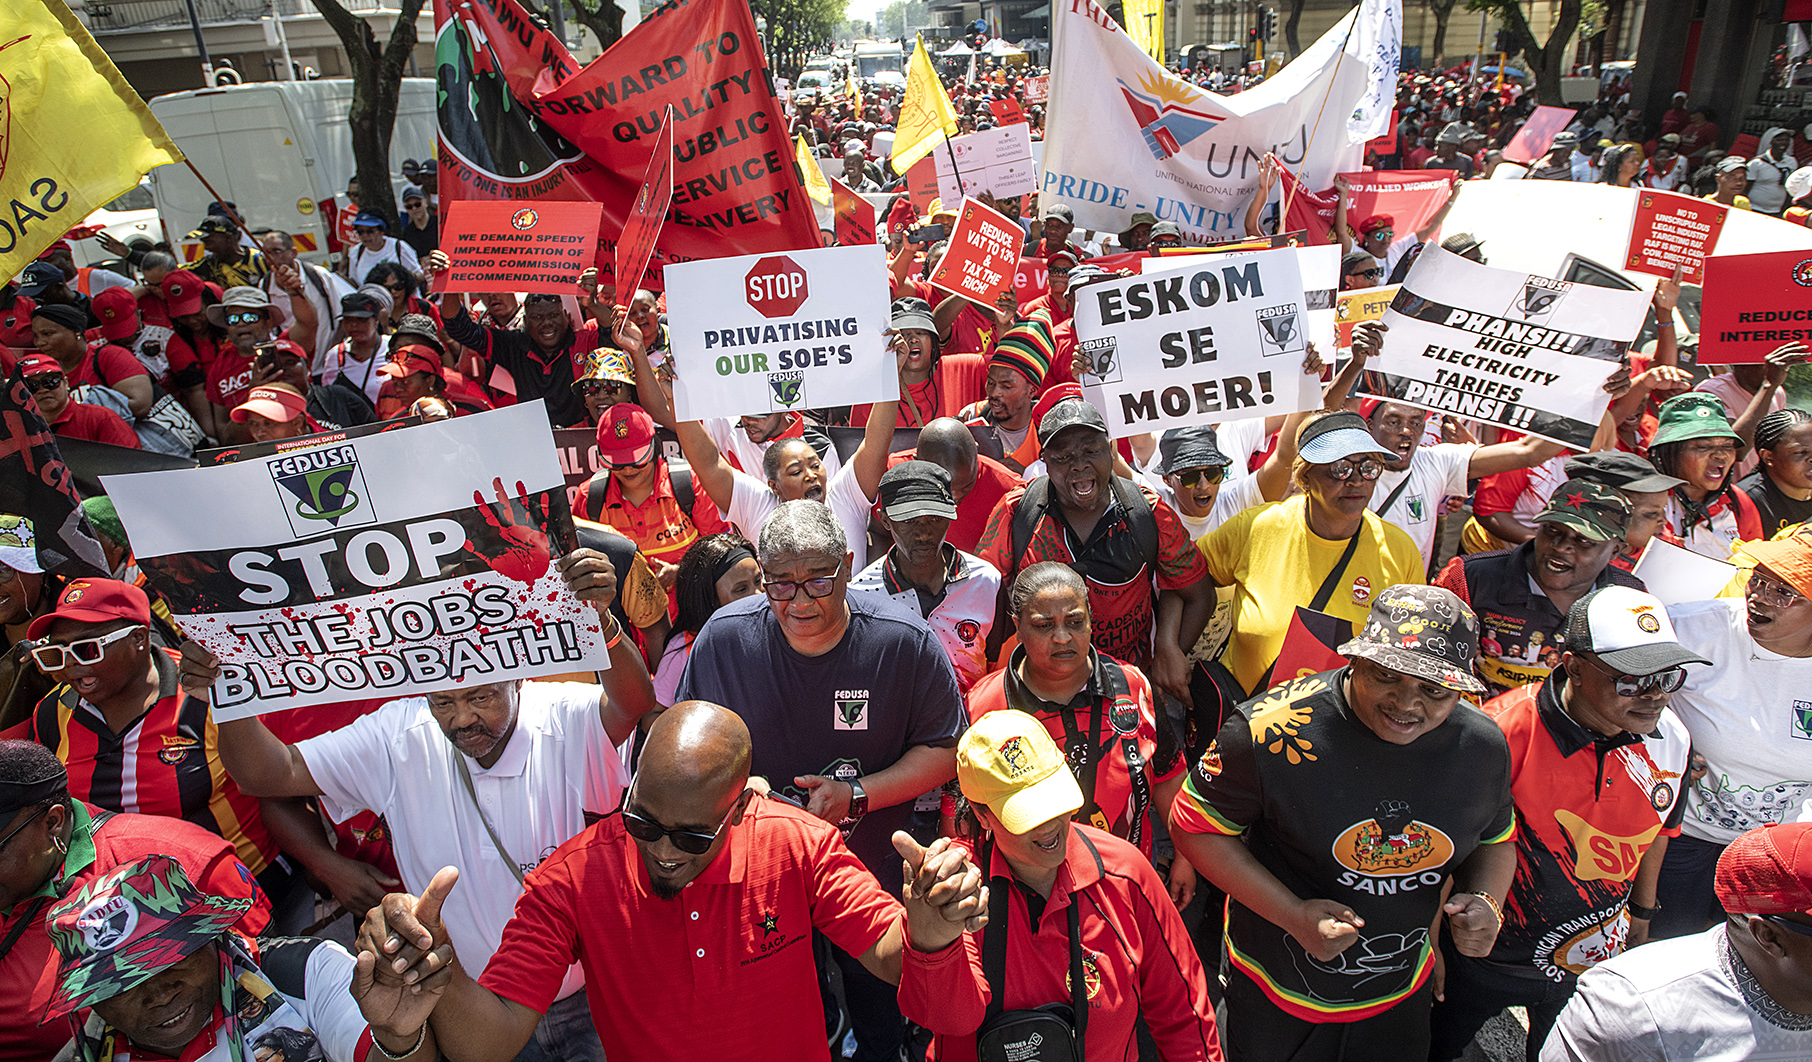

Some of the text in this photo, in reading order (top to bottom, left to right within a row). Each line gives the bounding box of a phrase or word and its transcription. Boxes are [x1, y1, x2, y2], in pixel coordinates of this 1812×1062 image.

[530, 31, 740, 118] FORWARD TO
[612, 69, 752, 143] QUALITY
[673, 111, 769, 163] UBLIC
[473, 176, 498, 195] ONE
[515, 187, 529, 199] AN
[672, 150, 782, 205] ERVICE
[1155, 169, 1184, 185] UNITED
[1187, 181, 1233, 196] NATIONAL
[1365, 183, 1401, 192] ALLIED
[1043, 170, 1129, 210] PRIDE
[1156, 196, 1240, 232] UNITY
[1655, 213, 1711, 232] UNSCRUPULOUS
[1677, 209, 1698, 219] NO TO
[458, 234, 585, 243] WE DEMAND SPEEDY
[979, 221, 1014, 248] REDUCE
[1652, 222, 1709, 241] LEGAL INDUSTRY
[1652, 231, 1690, 246] TARGETING
[453, 247, 584, 257] IMPLEMENTATION OF
[966, 229, 1015, 265] VAT TO 13%
[1644, 239, 1661, 248] RAF
[1661, 242, 1668, 250] IS
[1668, 244, 1682, 253] NOT
[1687, 248, 1705, 258] CASH
[1663, 252, 1685, 263] DIRECT
[1685, 256, 1691, 265] IT
[1692, 258, 1702, 267] TO
[452, 260, 581, 270] ZONDO COMMISSION
[962, 260, 983, 278] TAX
[981, 268, 1002, 287] THE
[982, 255, 991, 267] &
[750, 272, 803, 301] STOP
[960, 275, 988, 295] RICH!
[1097, 262, 1263, 326] ESKOM
[1526, 275, 1573, 293] FEDUSA
[1256, 303, 1297, 318] FEDUSA
[704, 317, 858, 349] PRIVATISING
[1083, 337, 1115, 350] EDUSA
[1443, 309, 1582, 353] PHANSI!!
[1720, 329, 1812, 342] INTEREST
[1160, 326, 1217, 368] SE
[1475, 337, 1533, 359] HIGH
[715, 344, 853, 376] OUR SOE'S
[1422, 344, 1560, 386] ELECTRICITY
[768, 371, 803, 382] FEDUSA
[1435, 369, 1524, 402] TARIFFS
[1119, 370, 1275, 425] MOER!
[1403, 381, 1507, 421] PHANSI
[277, 439, 321, 450] INTERNATIONAL
[270, 444, 356, 477] FEDUSA
[228, 517, 466, 604] STOP
[1094, 588, 1108, 596] ONE
[232, 586, 516, 658] THE JOBS
[211, 620, 581, 707] BLOODBATH!
[834, 689, 869, 700] FEDUSA
[1336, 871, 1442, 896] SANCO
[760, 935, 787, 953] SACP
